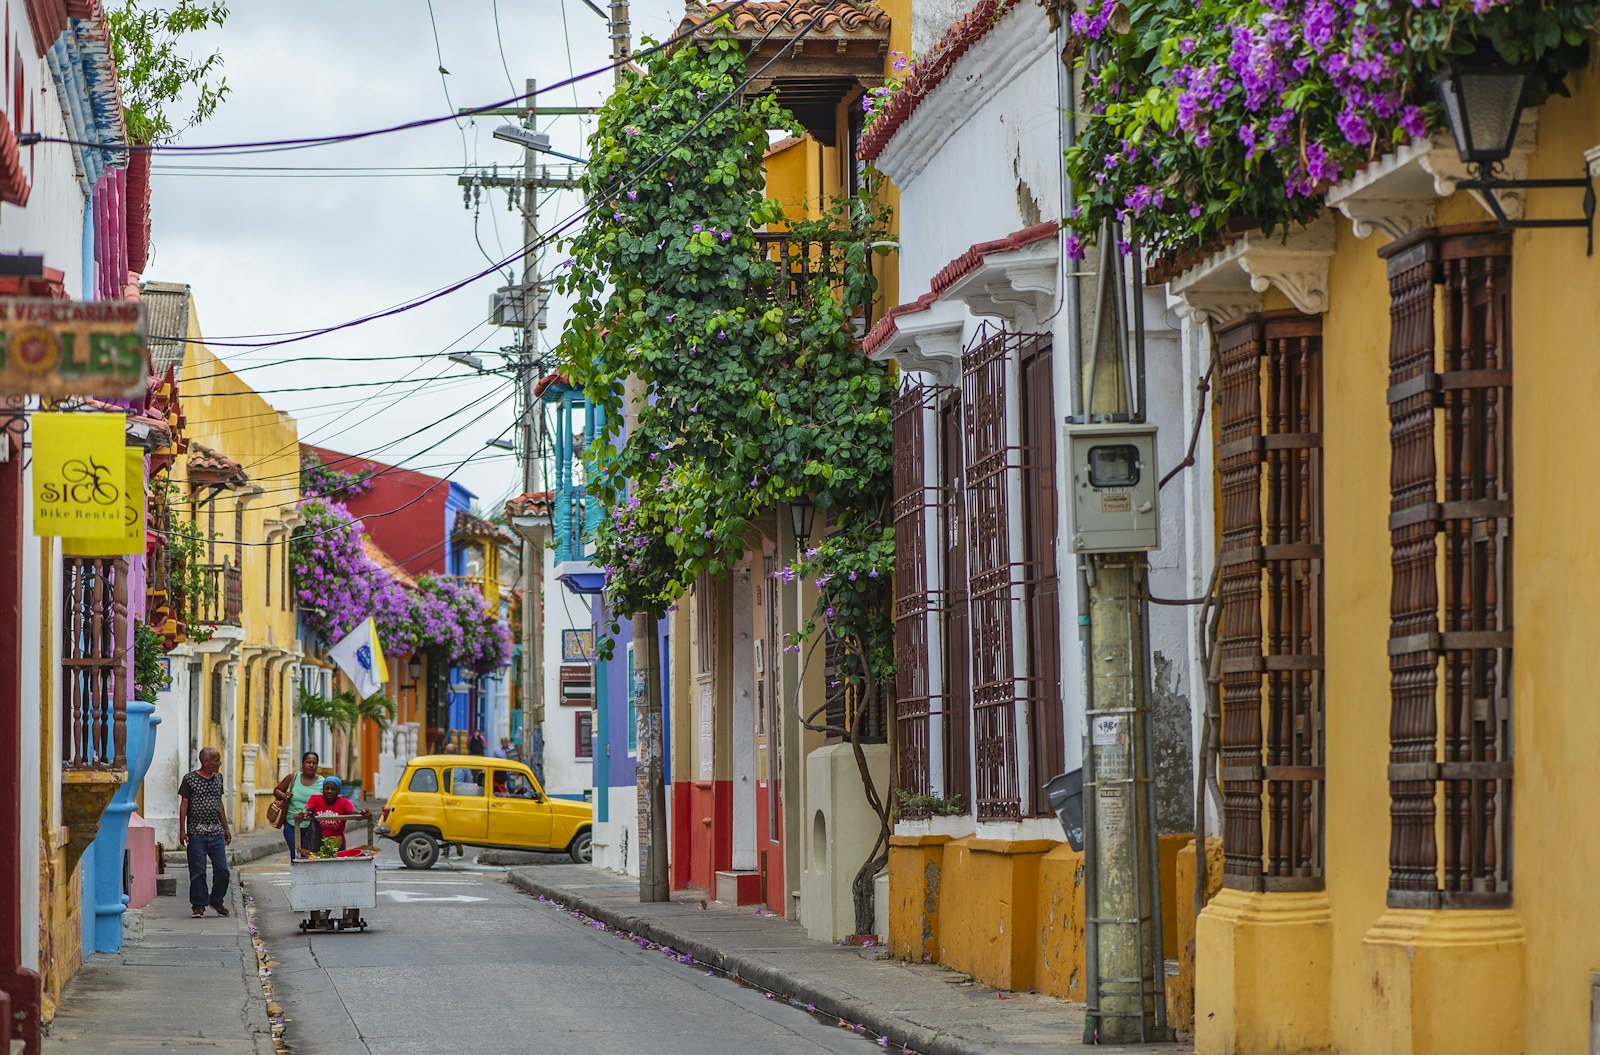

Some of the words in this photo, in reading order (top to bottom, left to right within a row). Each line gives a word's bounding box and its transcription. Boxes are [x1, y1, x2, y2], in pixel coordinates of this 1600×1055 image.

[15, 303, 139, 321] VEGETARIANO
[40, 482, 119, 505] SICO
[40, 508, 70, 518] Bike
[75, 510, 119, 519] Rental
